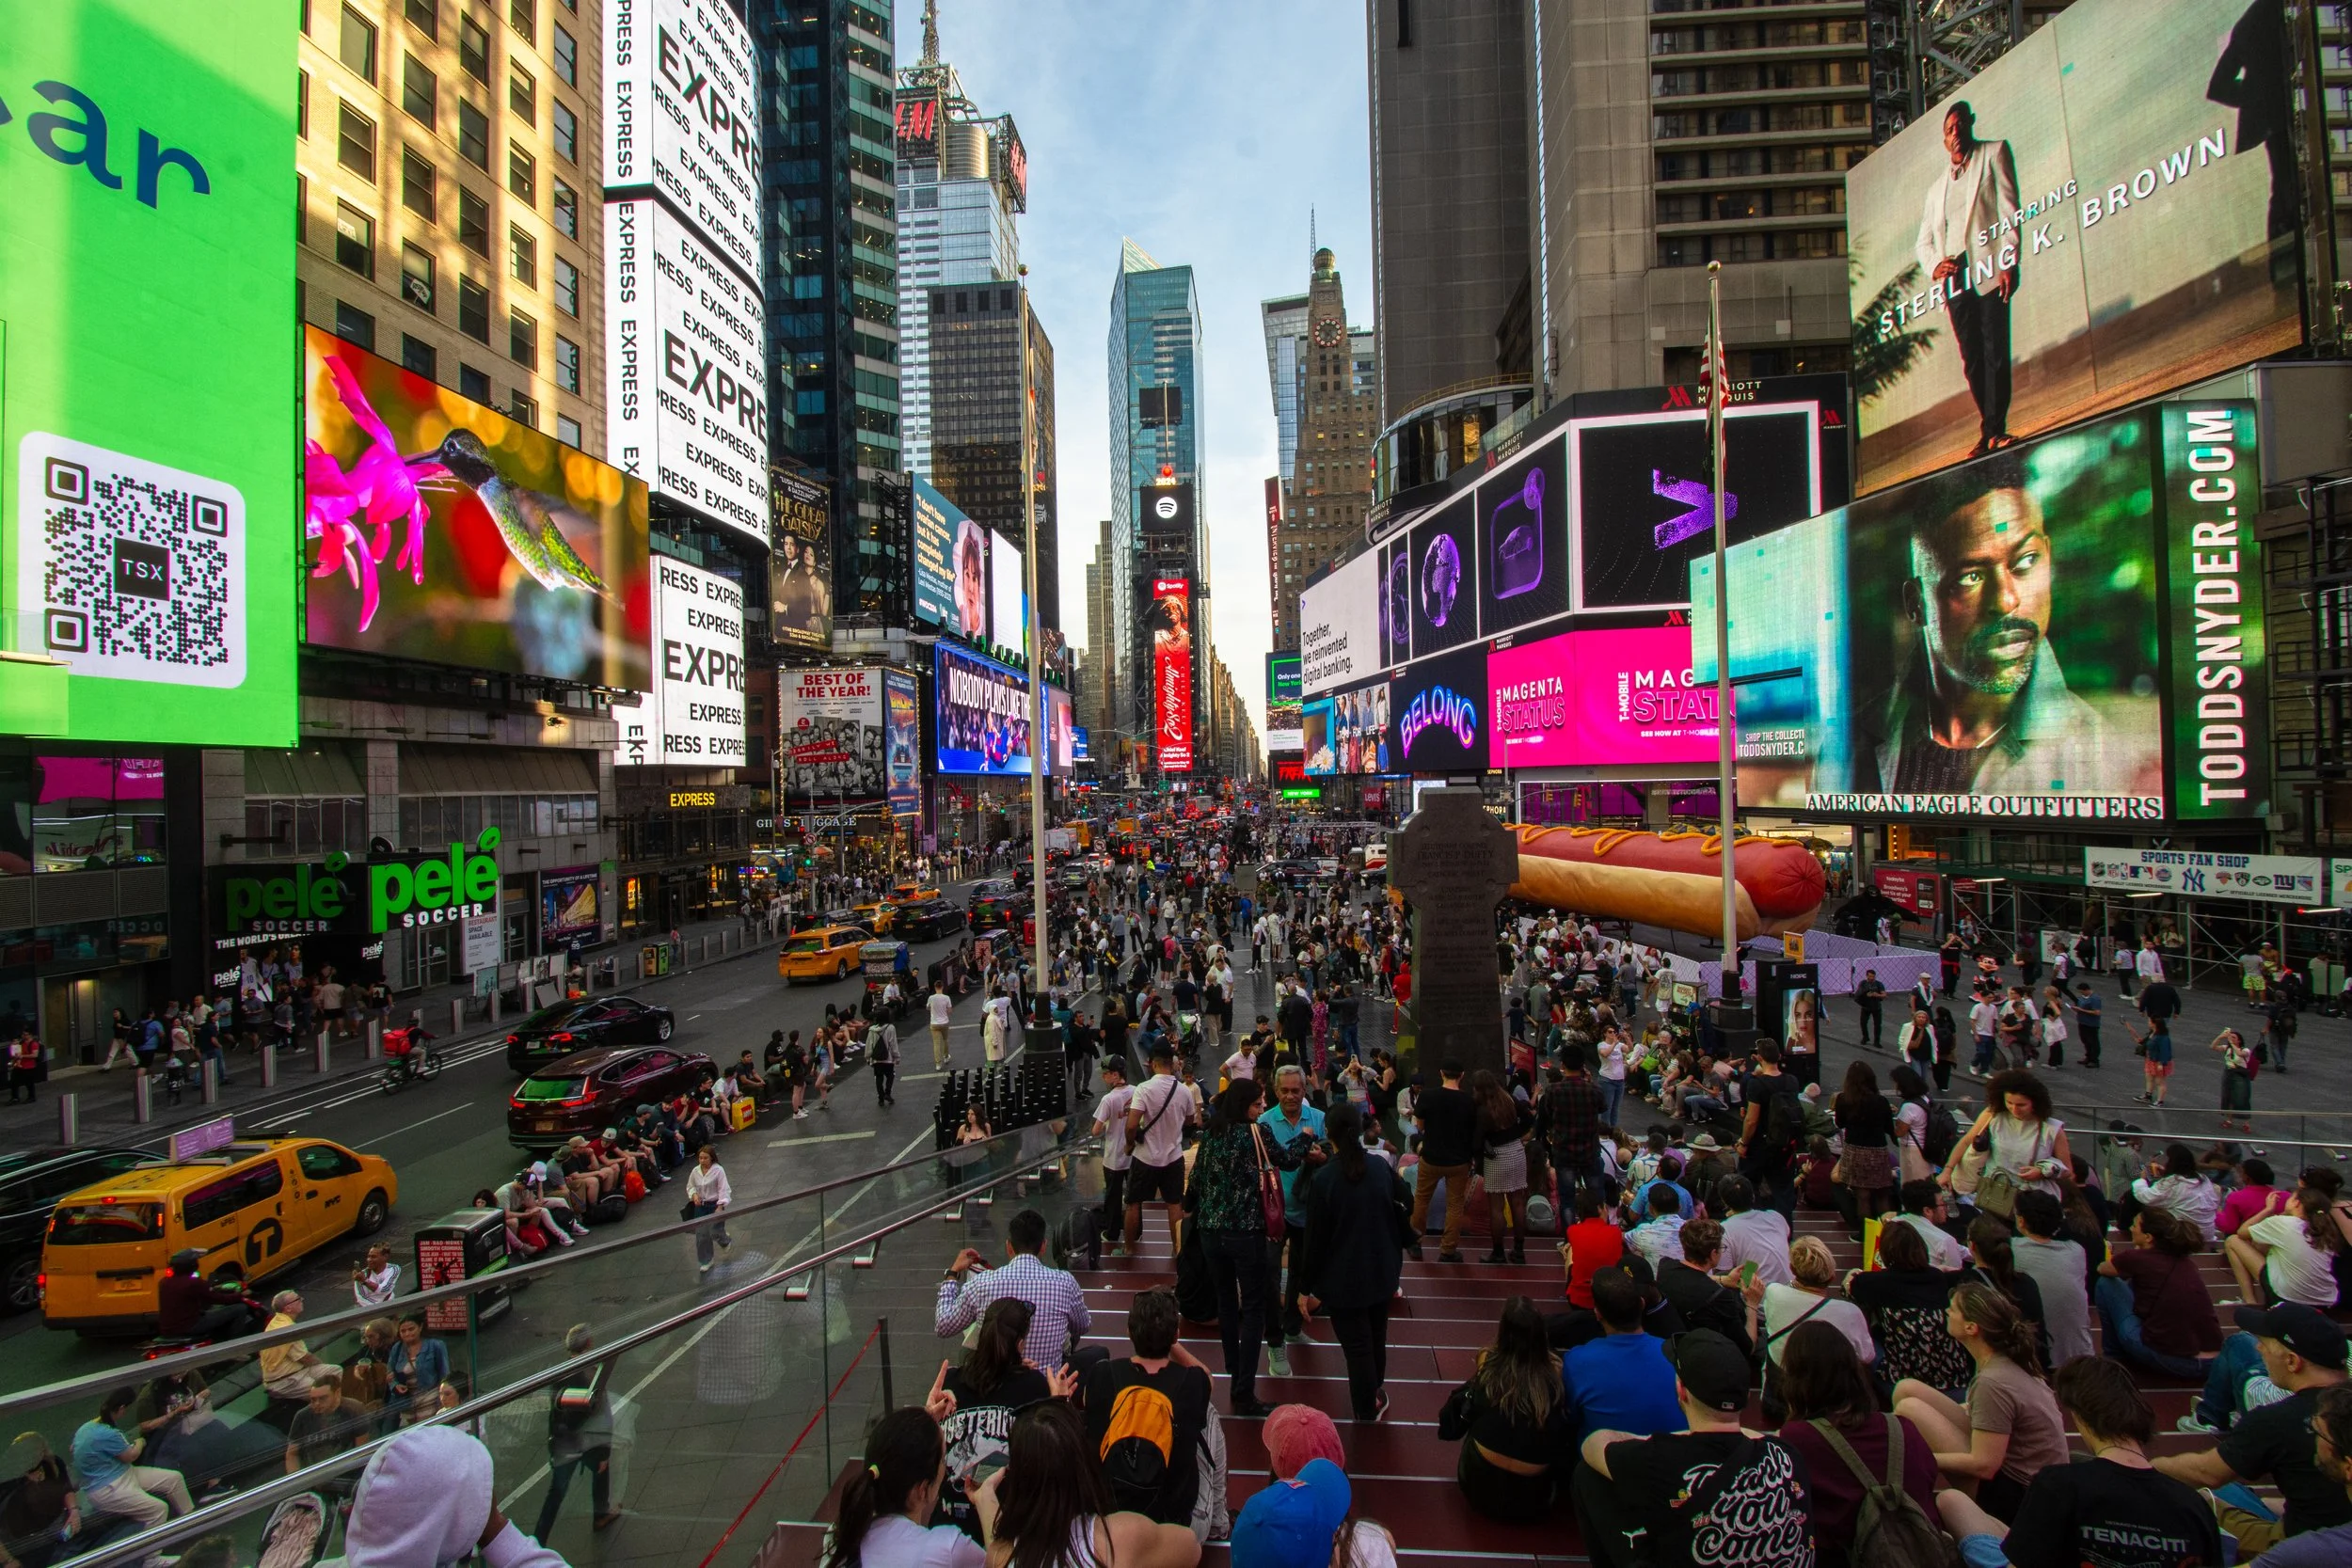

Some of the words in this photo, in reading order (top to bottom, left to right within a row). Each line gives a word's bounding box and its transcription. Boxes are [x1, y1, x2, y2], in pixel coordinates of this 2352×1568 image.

[679, 18, 735, 100] EXPRESS
[697, 6, 749, 86] EXPRESS
[0, 80, 211, 209] ar
[617, 81, 632, 179] EXPRESS
[697, 131, 751, 201] EXPRESS
[680, 147, 737, 217] EXPRESS
[1979, 179, 2078, 246] STARRING
[699, 201, 753, 266] EXPRESS
[1881, 245, 2018, 334] STERLING
[2032, 222, 2065, 255] K.
[2081, 128, 2226, 229] BROWN
[618, 201, 637, 304] EXPRESS
[681, 239, 739, 302] EXPRESS
[701, 289, 754, 346] EXPRESS
[683, 309, 740, 368] EXPRESS
[621, 319, 639, 421] EXPRESS
[704, 417, 756, 463] EXPRESS
[1497, 432, 1523, 452] MARRIOTT
[1498, 443, 1520, 463] MARQUIS
[686, 441, 742, 487] EXPRESS
[706, 488, 758, 529] EXPRESS
[795, 502, 826, 527] GREAT
[1371, 499, 1392, 515] MARRIOTT
[1371, 509, 1390, 521] MARQUIS
[781, 514, 821, 541] GATSBY
[121, 559, 164, 581] TSX
[2186, 409, 2248, 806] TODDSNYDER.COM
[688, 608, 739, 640] EXPRESS
[1302, 622, 1331, 647] Together,
[1497, 635, 1513, 643] MARRIOTT
[1303, 652, 1311, 667] we
[1312, 630, 1347, 661] reinvented
[1497, 641, 1512, 650] MARQUIS
[663, 638, 744, 693] EXPRE
[804, 673, 841, 686] BEST
[845, 673, 865, 684] OF
[1303, 662, 1322, 686] digital
[1324, 655, 1353, 677] banking.
[797, 687, 825, 698] THE
[829, 686, 870, 697] YEAR!
[949, 667, 984, 710] NOBODY
[985, 679, 1006, 715] PLAYS
[1007, 689, 1020, 719] LIKE
[1163, 657, 1181, 711] Almighty
[1502, 676, 1563, 703] MAGENTA
[1618, 672, 1629, 721] T-MOBILE
[690, 703, 741, 726] EXPRESS
[1167, 711, 1181, 727] So
[1400, 685, 1477, 759] BELONG
[1502, 696, 1565, 732] STATUS
[1164, 720, 1183, 740] 2
[1745, 733, 1760, 742] SHOP
[1763, 731, 1773, 741] THE
[1740, 742, 1804, 757] TODDSNYDER.C
[670, 792, 715, 807] EXPRESS
[1806, 794, 1904, 813] AMERICAN
[1914, 795, 1981, 815] EAGLE
[1989, 797, 2162, 819] OUTFITTERS
[2141, 851, 2185, 865] SPORTS
[2188, 853, 2213, 866] FAN
[2217, 855, 2249, 868] SHOP
[226, 851, 349, 931] pelé
[371, 826, 501, 934] pelé
[550, 875, 575, 884] OPPORTUNITY
[252, 921, 329, 932] SOCCER
[402, 903, 483, 928] SOCCER
[469, 916, 497, 927] RESTAURANT
[469, 926, 483, 934] SPACE
[216, 938, 235, 950] THE
[237, 934, 277, 946] WORLD'S
[362, 941, 383, 958] pelé
[469, 930, 493, 941] AVAILABLE
[215, 966, 241, 985] pelé
[325, 1195, 341, 1209] NYC
[1683, 1442, 1792, 1497] Tank
[1710, 1487, 1789, 1534] You
[1692, 1517, 1803, 1564] Come
